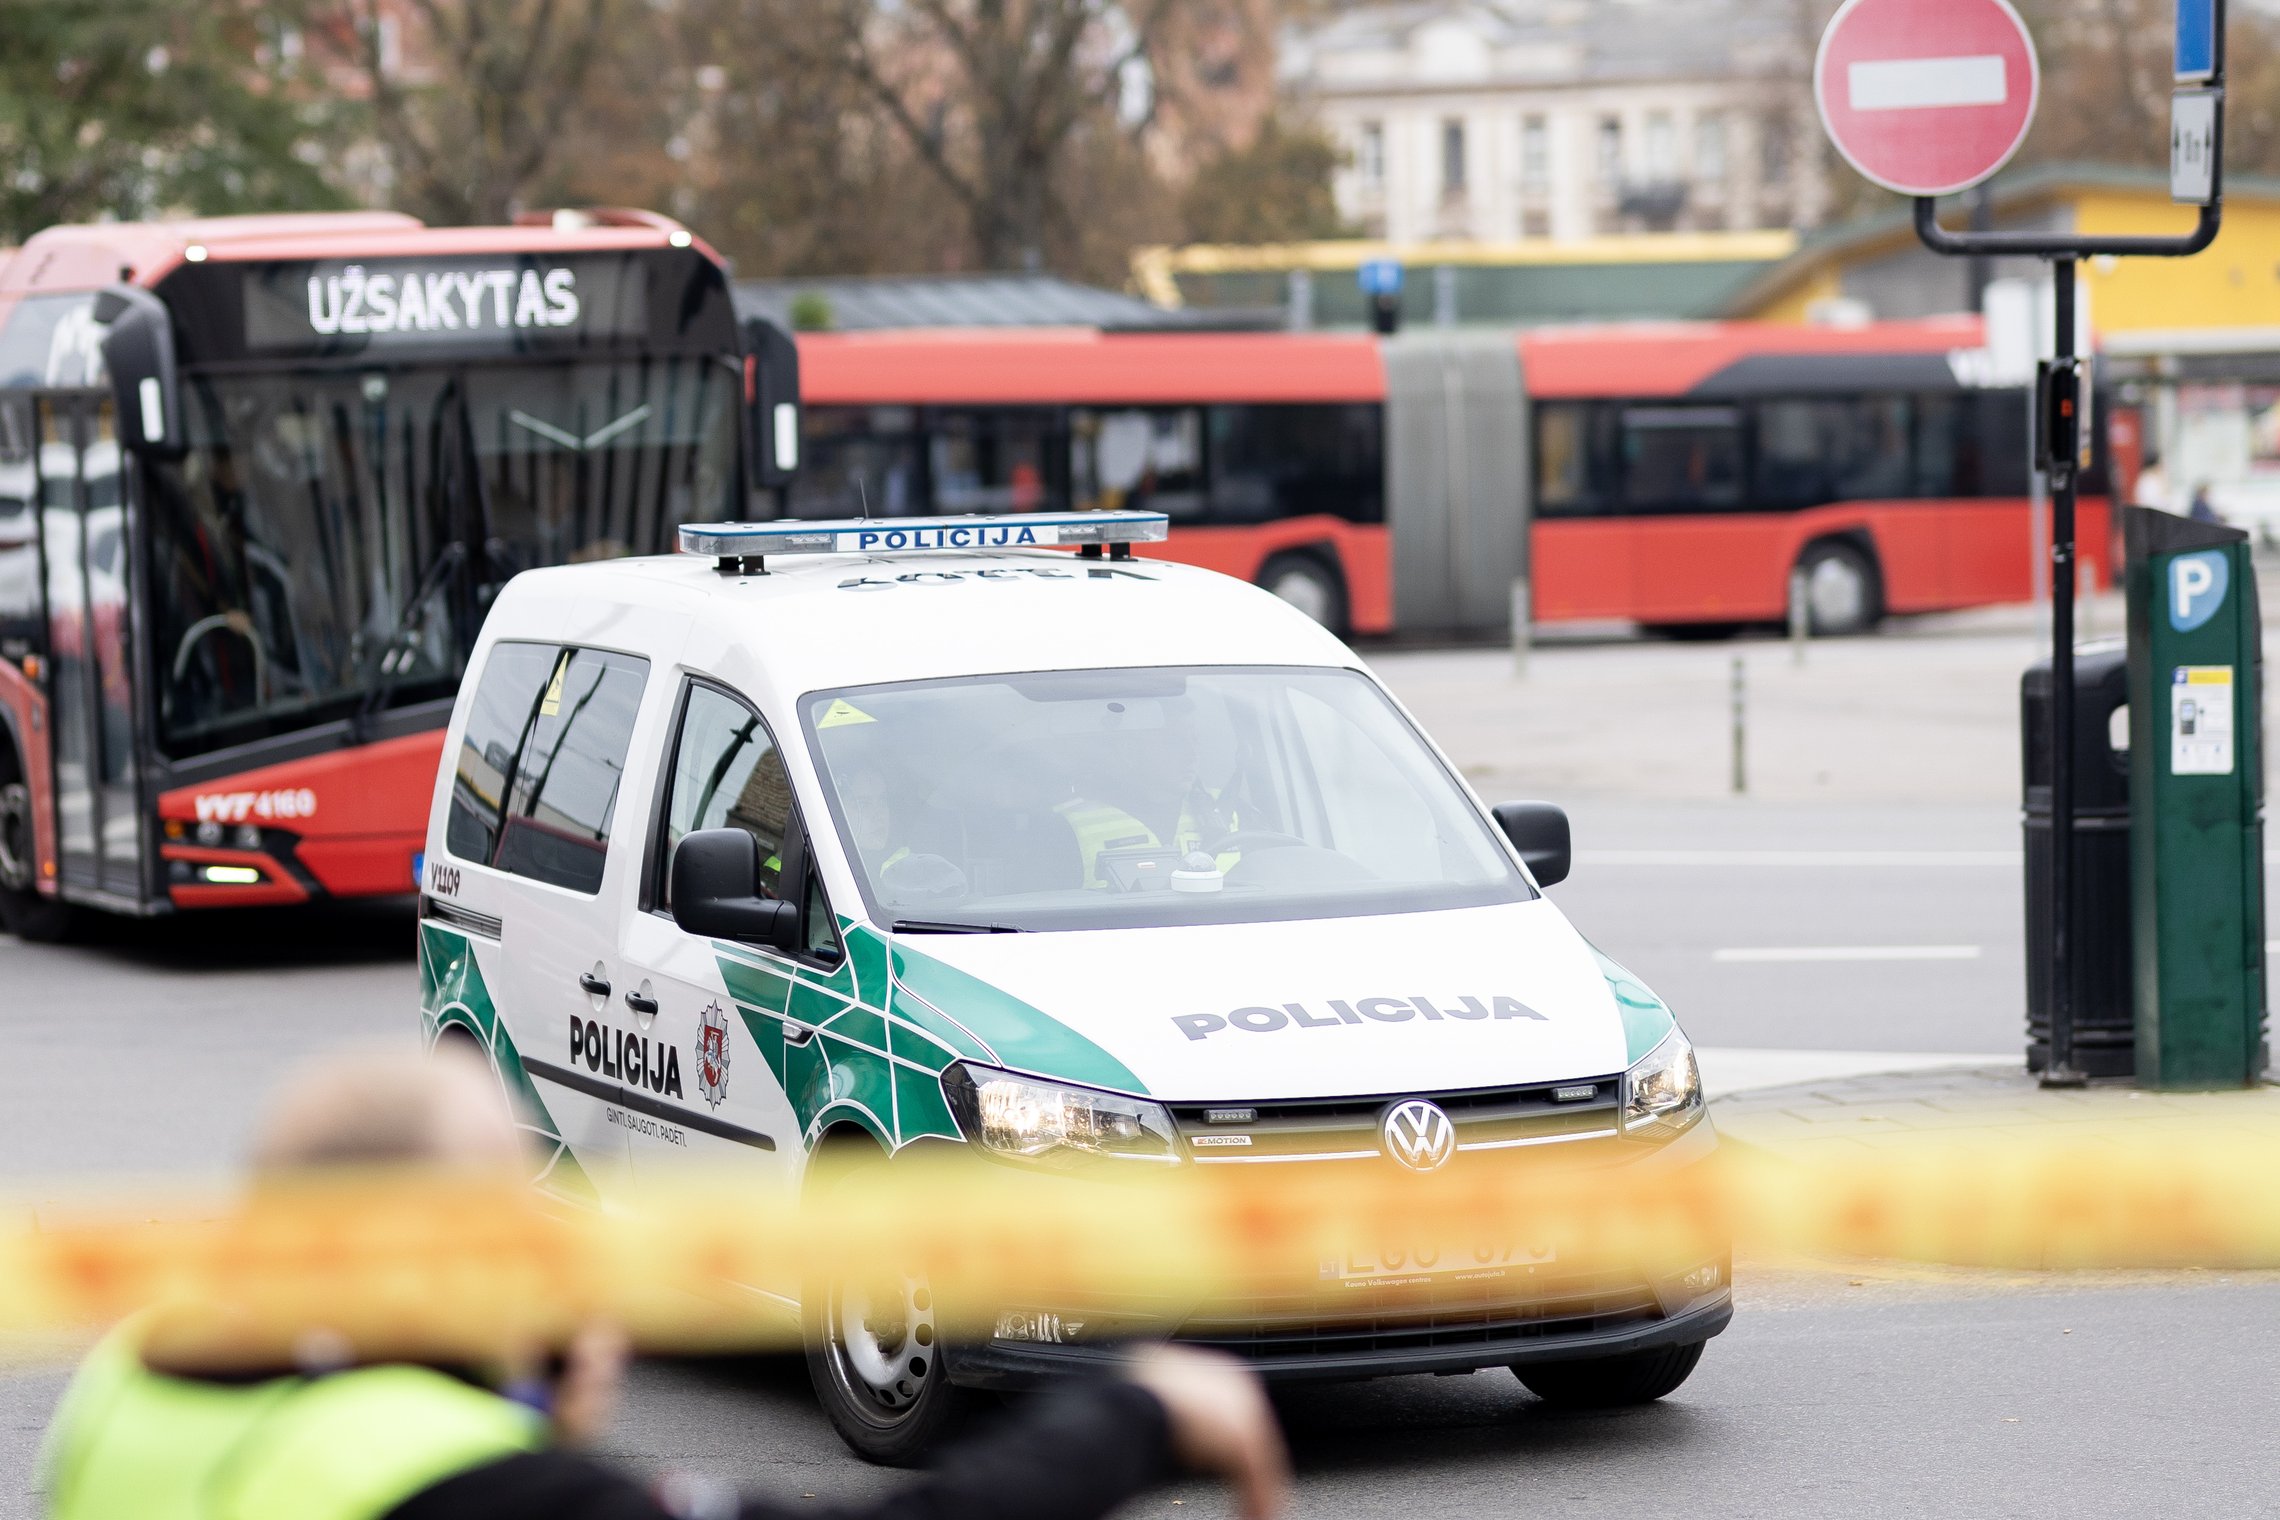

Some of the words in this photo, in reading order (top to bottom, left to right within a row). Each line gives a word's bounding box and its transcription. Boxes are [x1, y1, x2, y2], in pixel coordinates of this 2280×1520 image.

[308, 265, 580, 335] UŽSAKYTAS
[859, 526, 1036, 550] POLICIJA
[2176, 558, 2212, 618] P
[431, 862, 461, 897] V1109
[1171, 995, 1550, 1041] POLICIJA
[570, 1014, 684, 1100] POLICIJA
[1385, 1100, 1455, 1172] VW
